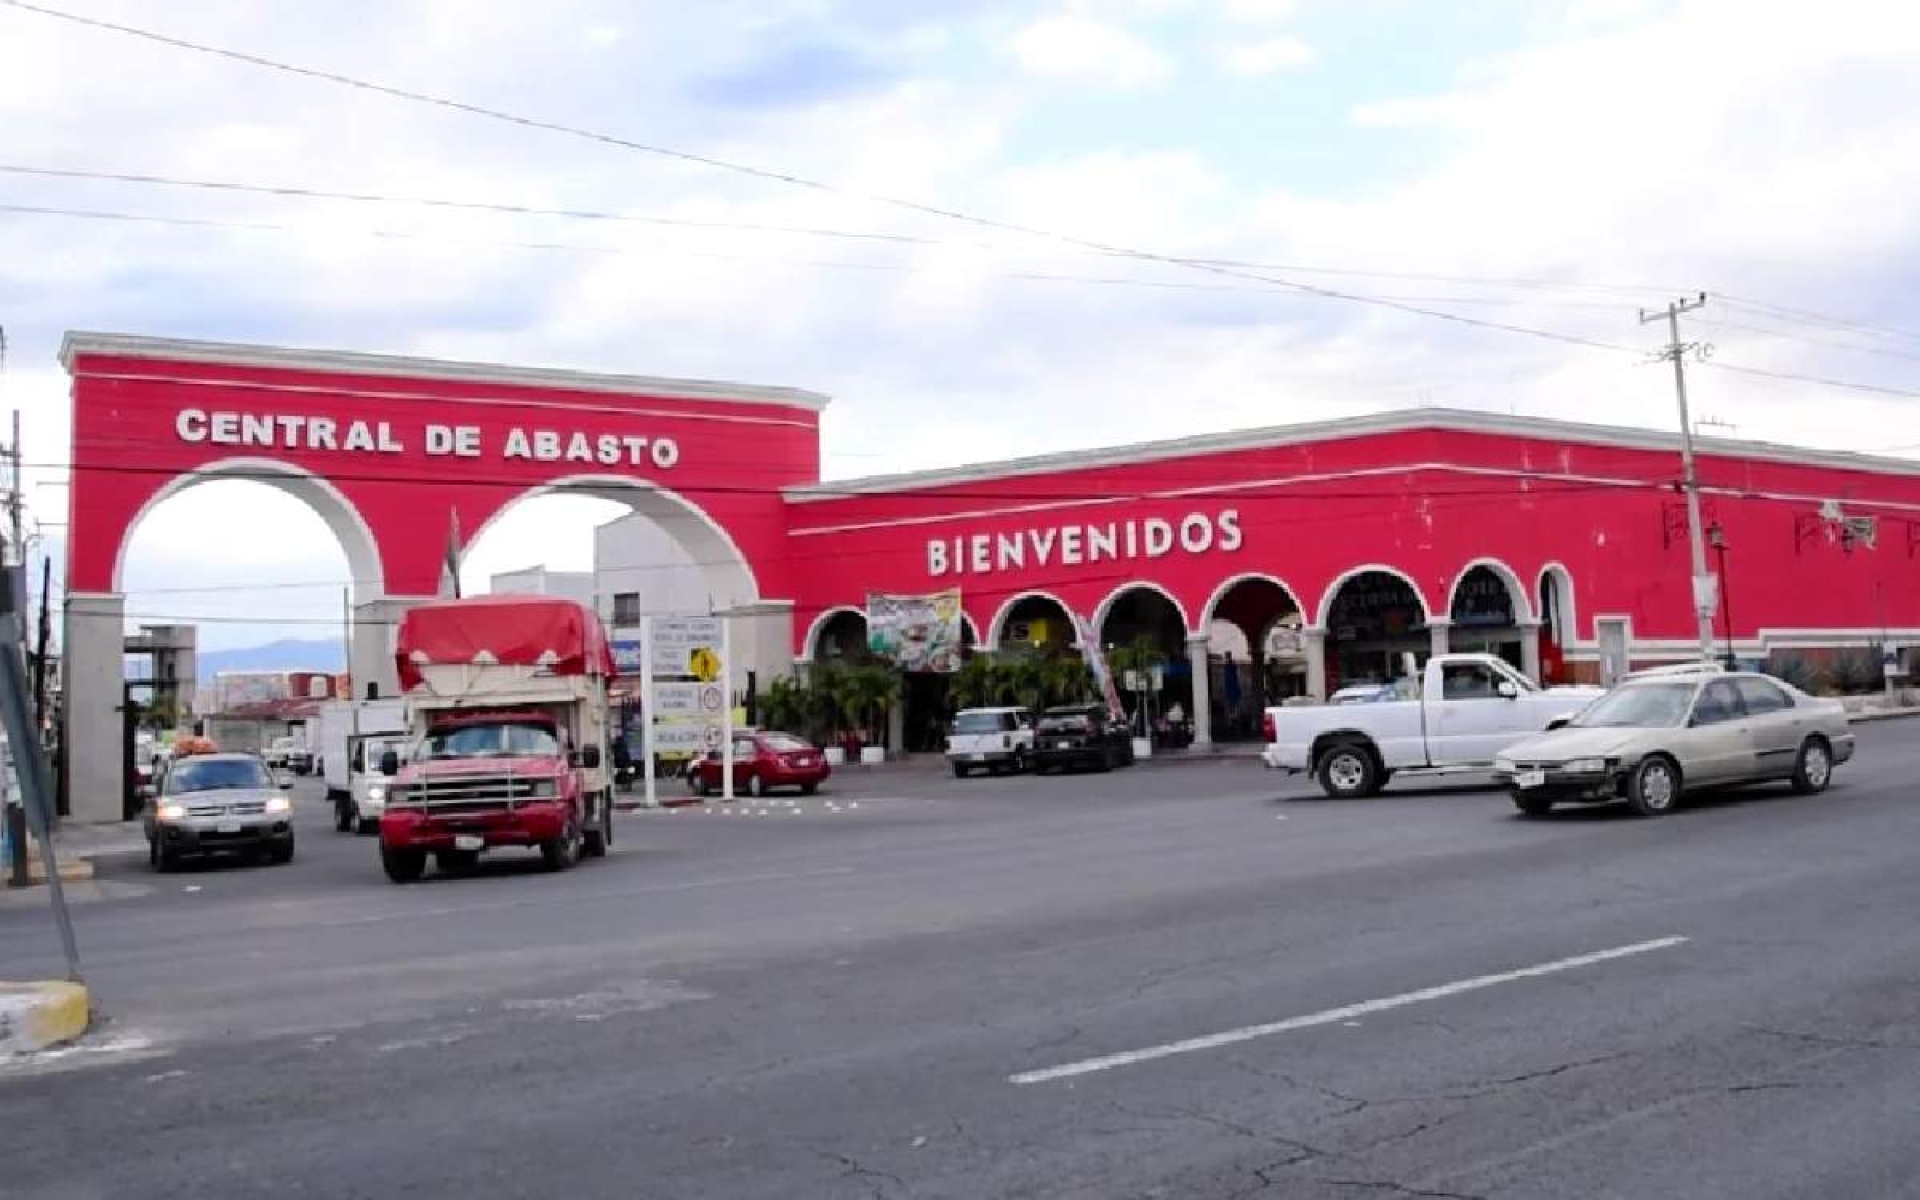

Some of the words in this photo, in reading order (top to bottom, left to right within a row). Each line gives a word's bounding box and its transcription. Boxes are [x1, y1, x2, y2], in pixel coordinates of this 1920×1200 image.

[175, 408, 404, 453] CENTRAL
[425, 423, 482, 458] DE
[503, 427, 680, 469] ABASTO
[927, 508, 1244, 577] BIENVENIDOS
